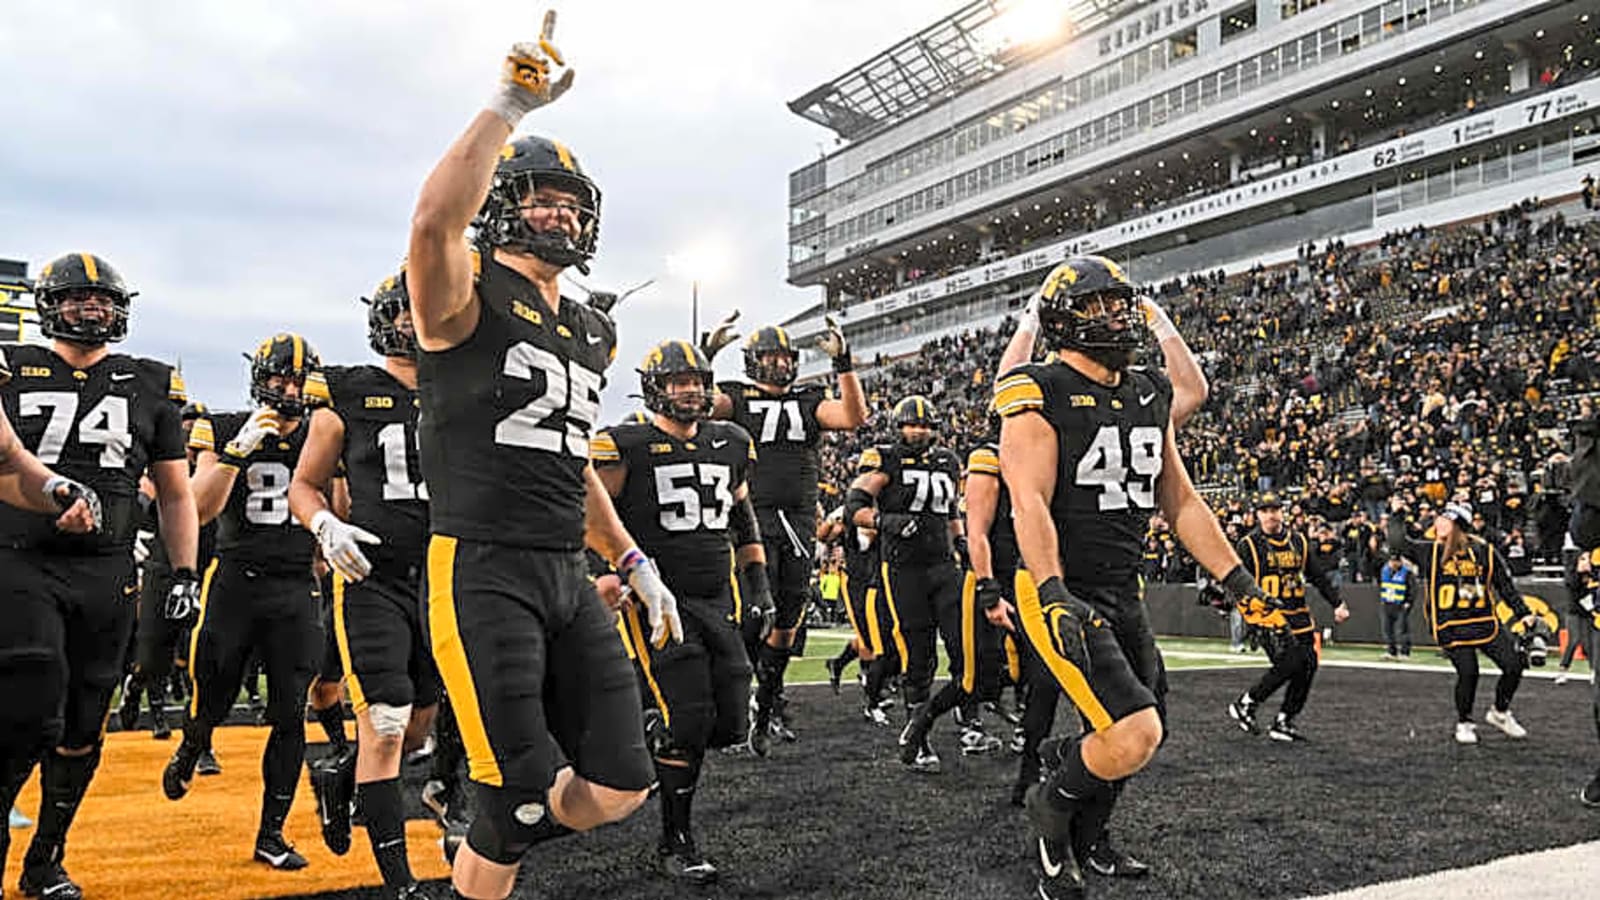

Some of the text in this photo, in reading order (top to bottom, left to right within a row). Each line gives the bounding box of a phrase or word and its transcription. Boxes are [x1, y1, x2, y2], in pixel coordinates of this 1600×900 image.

[1452, 128, 1461, 144] 1
[1525, 102, 1551, 123] 77
[1374, 149, 1397, 168] 62
[19, 391, 133, 469] 74
[495, 341, 600, 460] 25
[749, 400, 806, 443] 71
[246, 461, 301, 526] 8
[377, 422, 430, 500] 1
[901, 469, 954, 513] 70
[1074, 425, 1164, 511] 49
[655, 463, 734, 532] 53
